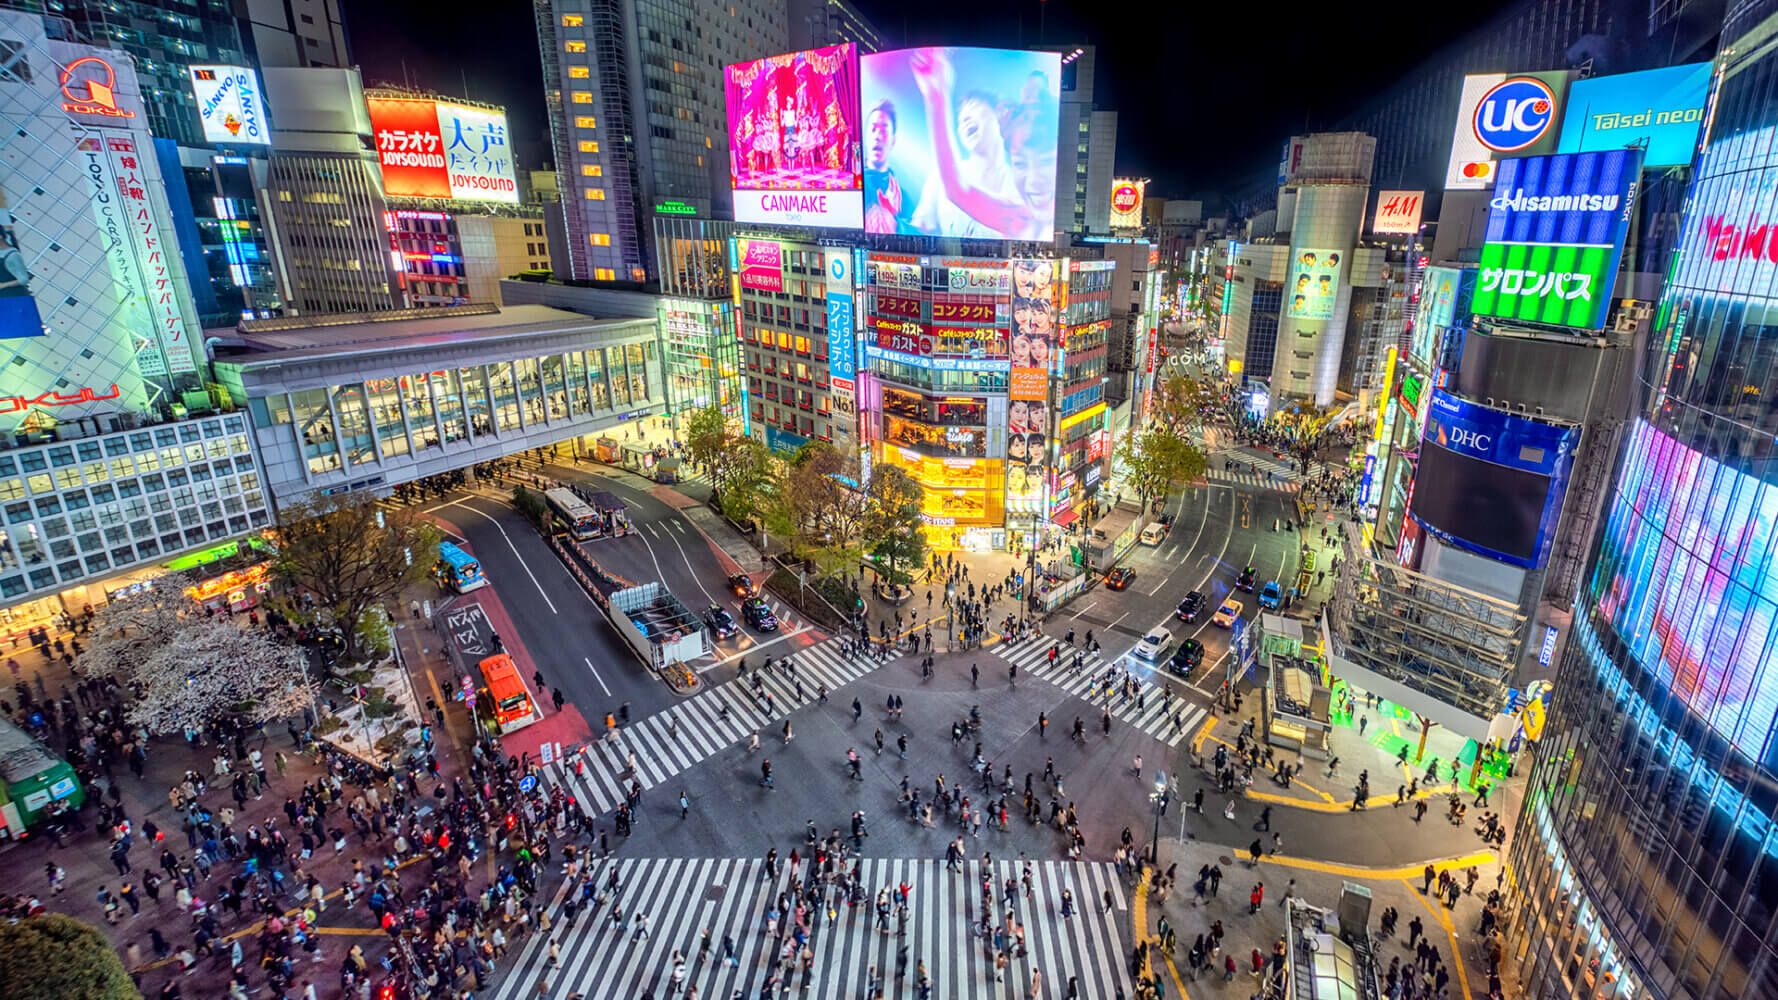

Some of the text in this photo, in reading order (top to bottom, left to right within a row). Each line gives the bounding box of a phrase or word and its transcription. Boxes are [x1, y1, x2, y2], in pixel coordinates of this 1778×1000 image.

[62, 103, 136, 119] TOKYU
[379, 129, 439, 151] カラオケ
[445, 117, 506, 155] 大声
[382, 152, 445, 168] JOYSOUND
[452, 174, 515, 192] JOYSOUND
[761, 194, 828, 213] CANMAKE
[1381, 195, 1419, 217] H&M
[1481, 267, 1593, 303] サロンパス
[933, 304, 994, 319] コンタクト
[891, 335, 917, 351] ガスト
[974, 327, 1004, 341] ガスト
[1449, 426, 1492, 452] DHC
